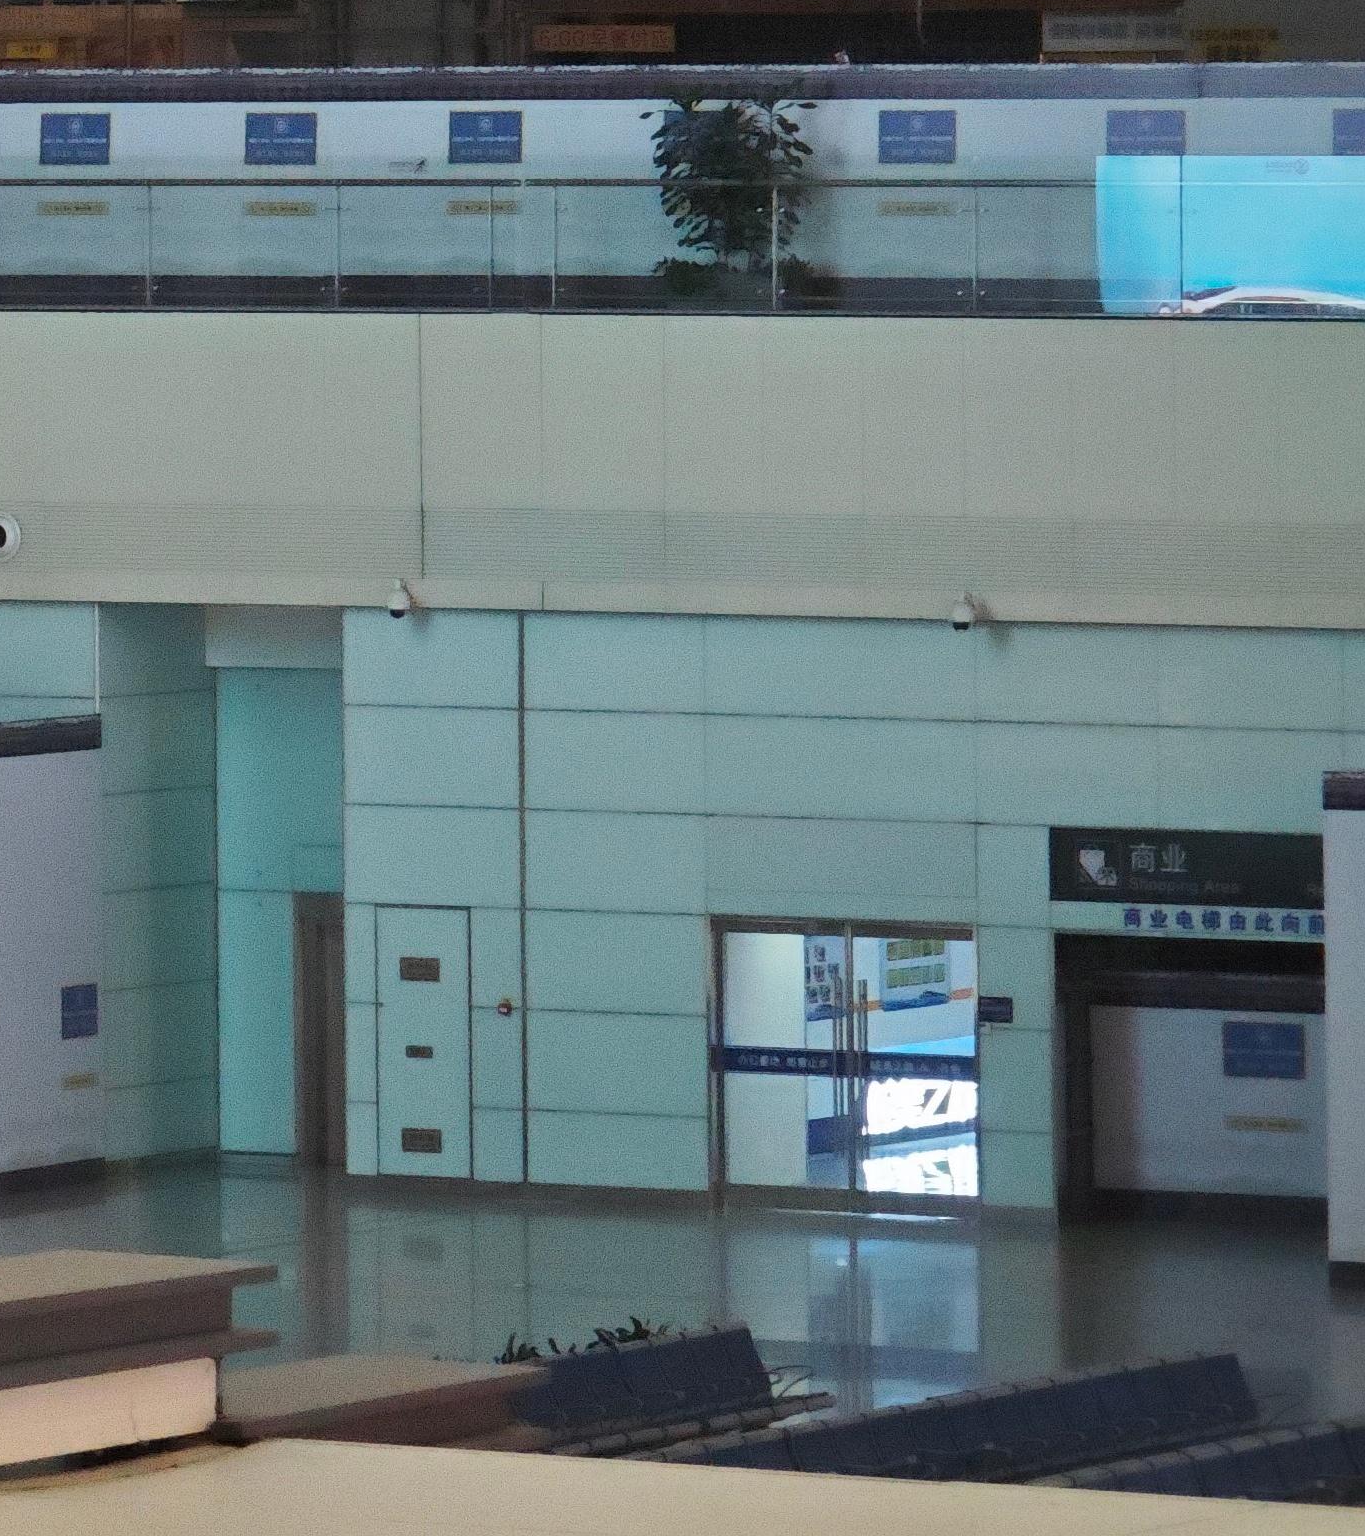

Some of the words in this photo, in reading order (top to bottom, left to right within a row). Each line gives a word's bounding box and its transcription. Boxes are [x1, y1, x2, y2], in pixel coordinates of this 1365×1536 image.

[1128, 843, 1188, 873] 商业
[1129, 878, 1198, 895] Shopping
[1204, 881, 1240, 895] Area
